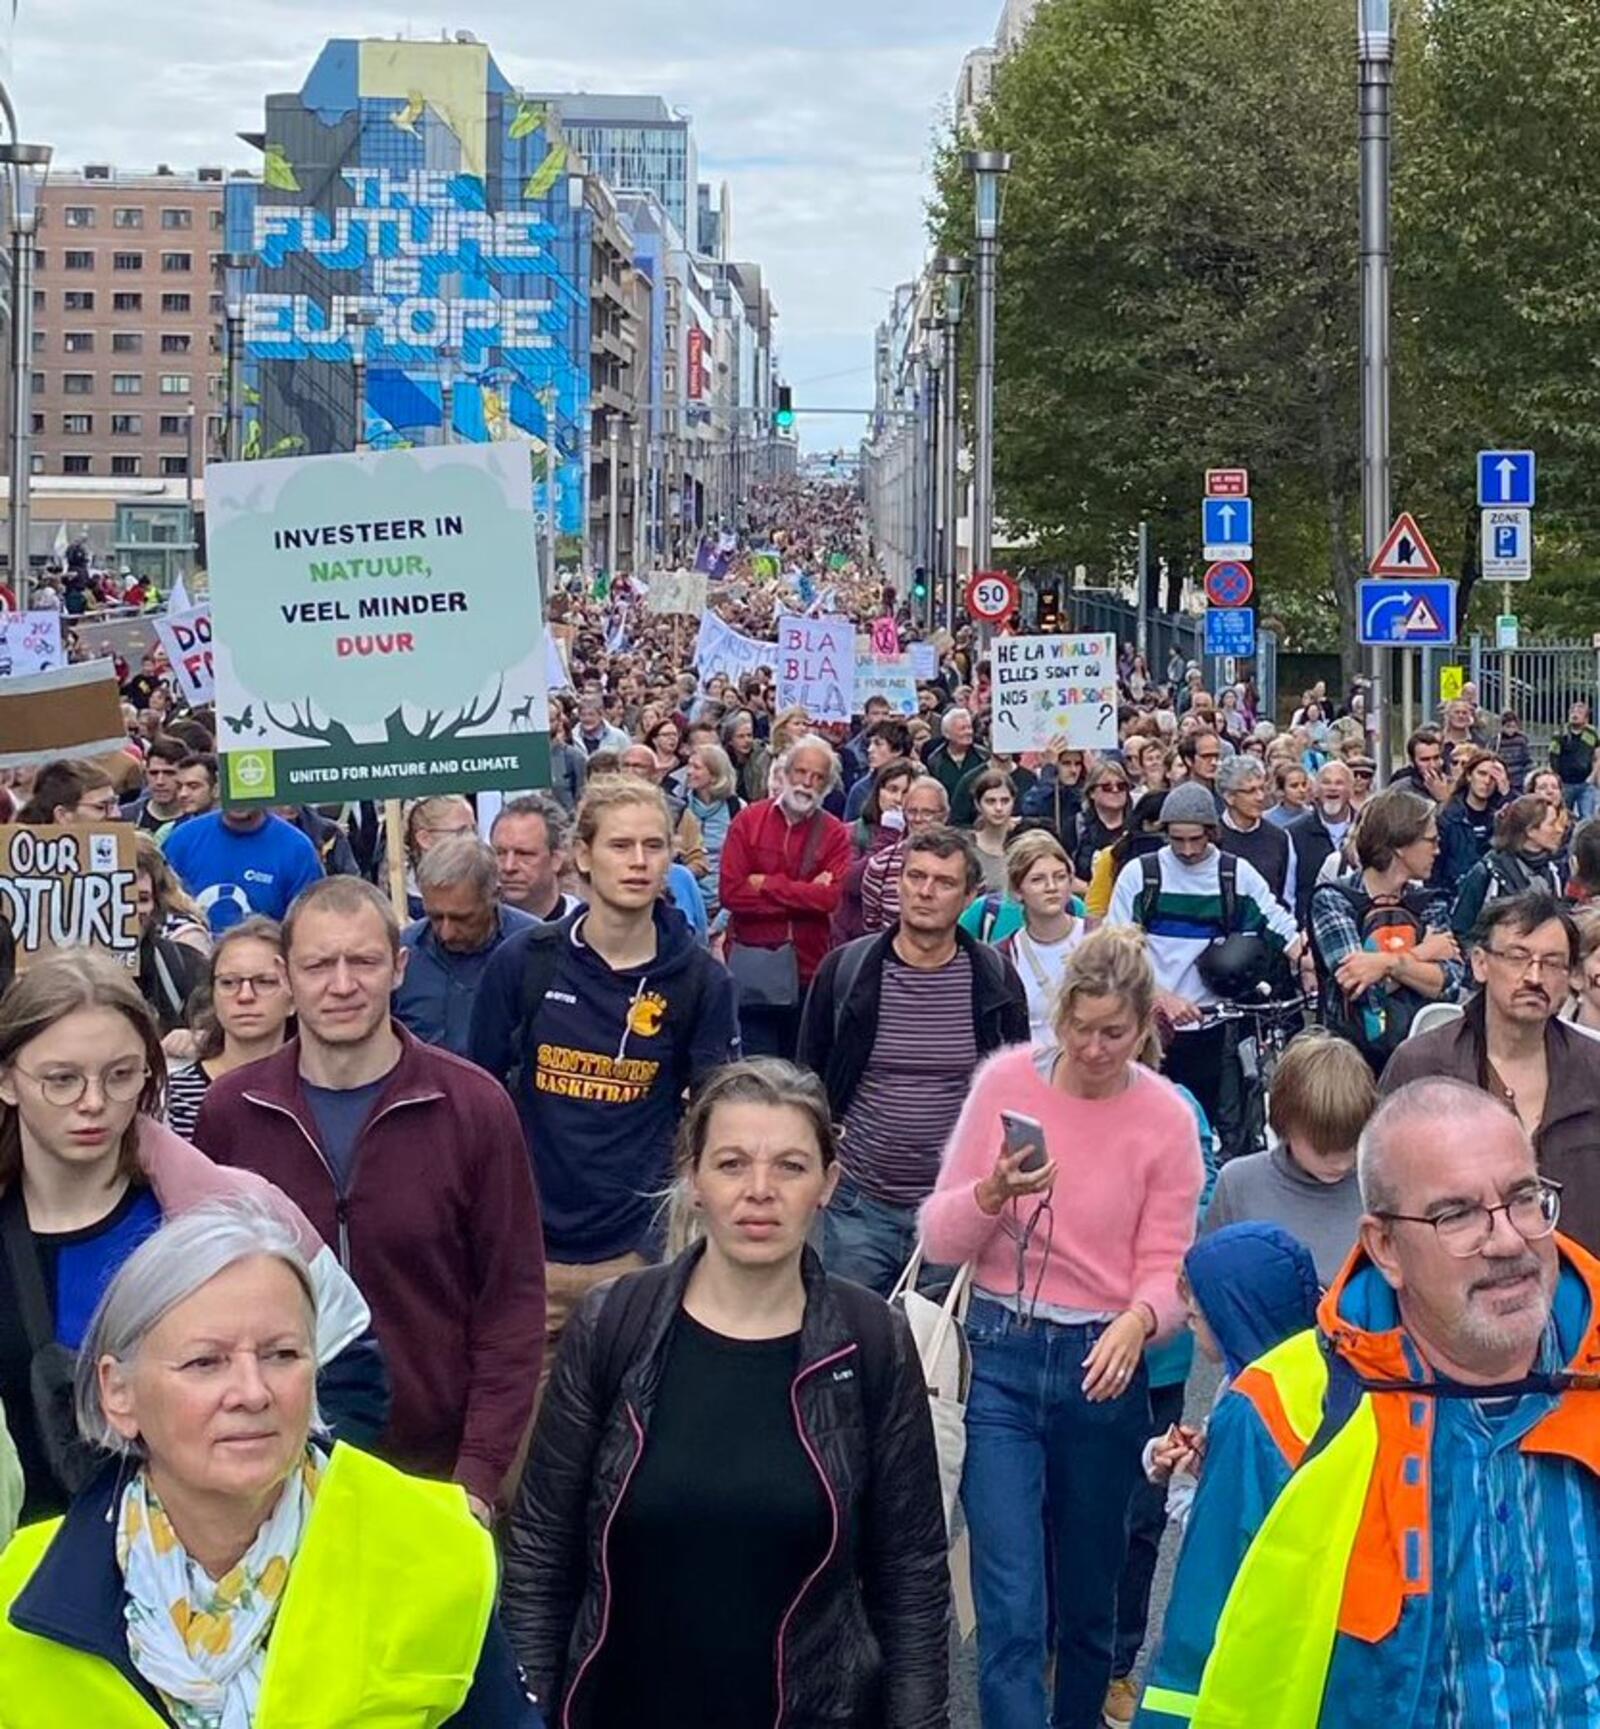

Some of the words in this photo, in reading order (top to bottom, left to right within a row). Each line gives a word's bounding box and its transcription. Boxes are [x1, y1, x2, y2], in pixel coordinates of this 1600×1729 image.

[341, 167, 455, 206] THE
[254, 205, 541, 257] FUTURE
[373, 258, 420, 294] IS
[243, 294, 551, 348] EUROPE
[1490, 513, 1520, 524] ZONE
[274, 519, 426, 549] INVESTEER
[436, 516, 463, 536] IN
[309, 555, 432, 582] NATUUR,
[978, 585, 1004, 602] 50
[281, 601, 350, 623] VEEL
[359, 592, 468, 619] MINDER
[336, 633, 414, 657] DUUR
[786, 629, 836, 652] BLA
[1025, 645, 1044, 660] LA
[784, 656, 838, 681] BLA
[999, 666, 1038, 684] ELLES
[1045, 665, 1078, 679] SONT
[781, 683, 847, 716] BLA
[1000, 689, 1028, 706] NOS
[289, 767, 340, 783] UNITED
[342, 766, 369, 780] FOR
[371, 762, 427, 778] NATURE
[429, 759, 459, 774] AND
[461, 756, 519, 772] CLIMATE
